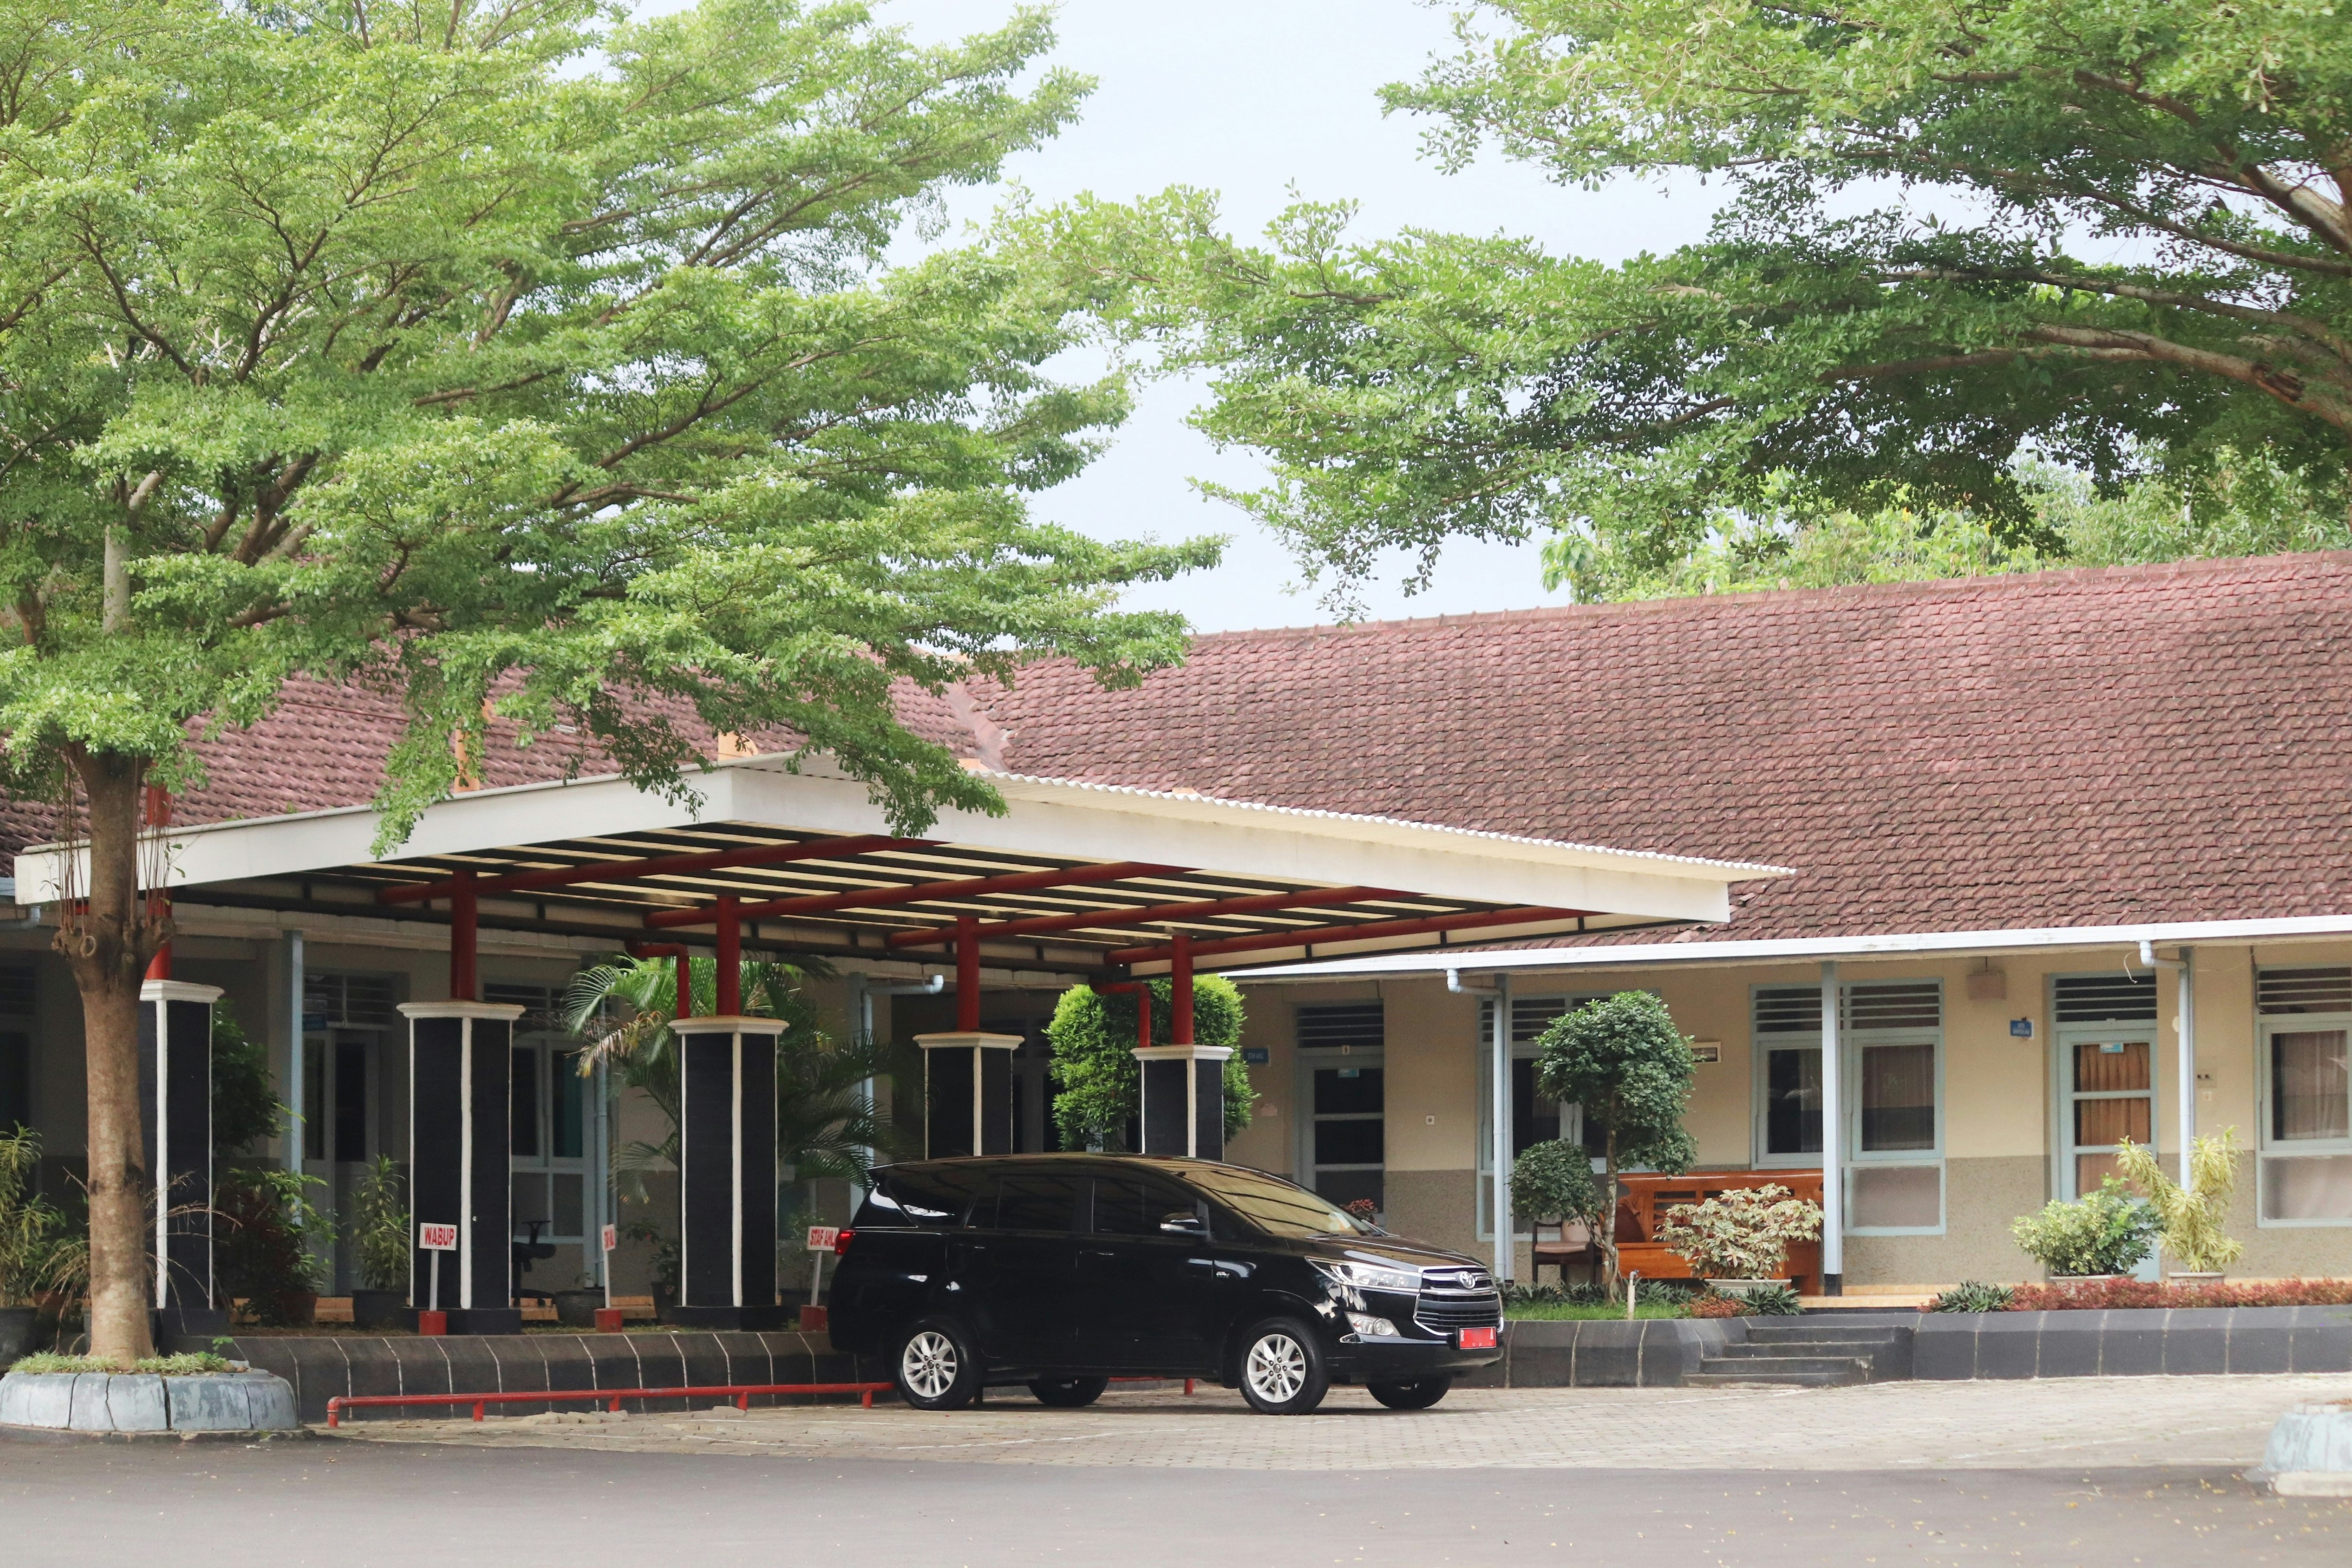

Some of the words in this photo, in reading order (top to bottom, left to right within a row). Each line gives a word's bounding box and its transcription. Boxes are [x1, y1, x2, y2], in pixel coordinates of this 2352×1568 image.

[424, 1227, 454, 1246] WABUP
[810, 1229, 824, 1246] STAF
[1461, 1329, 1464, 1341] R
[1490, 1328, 1494, 1340] A
